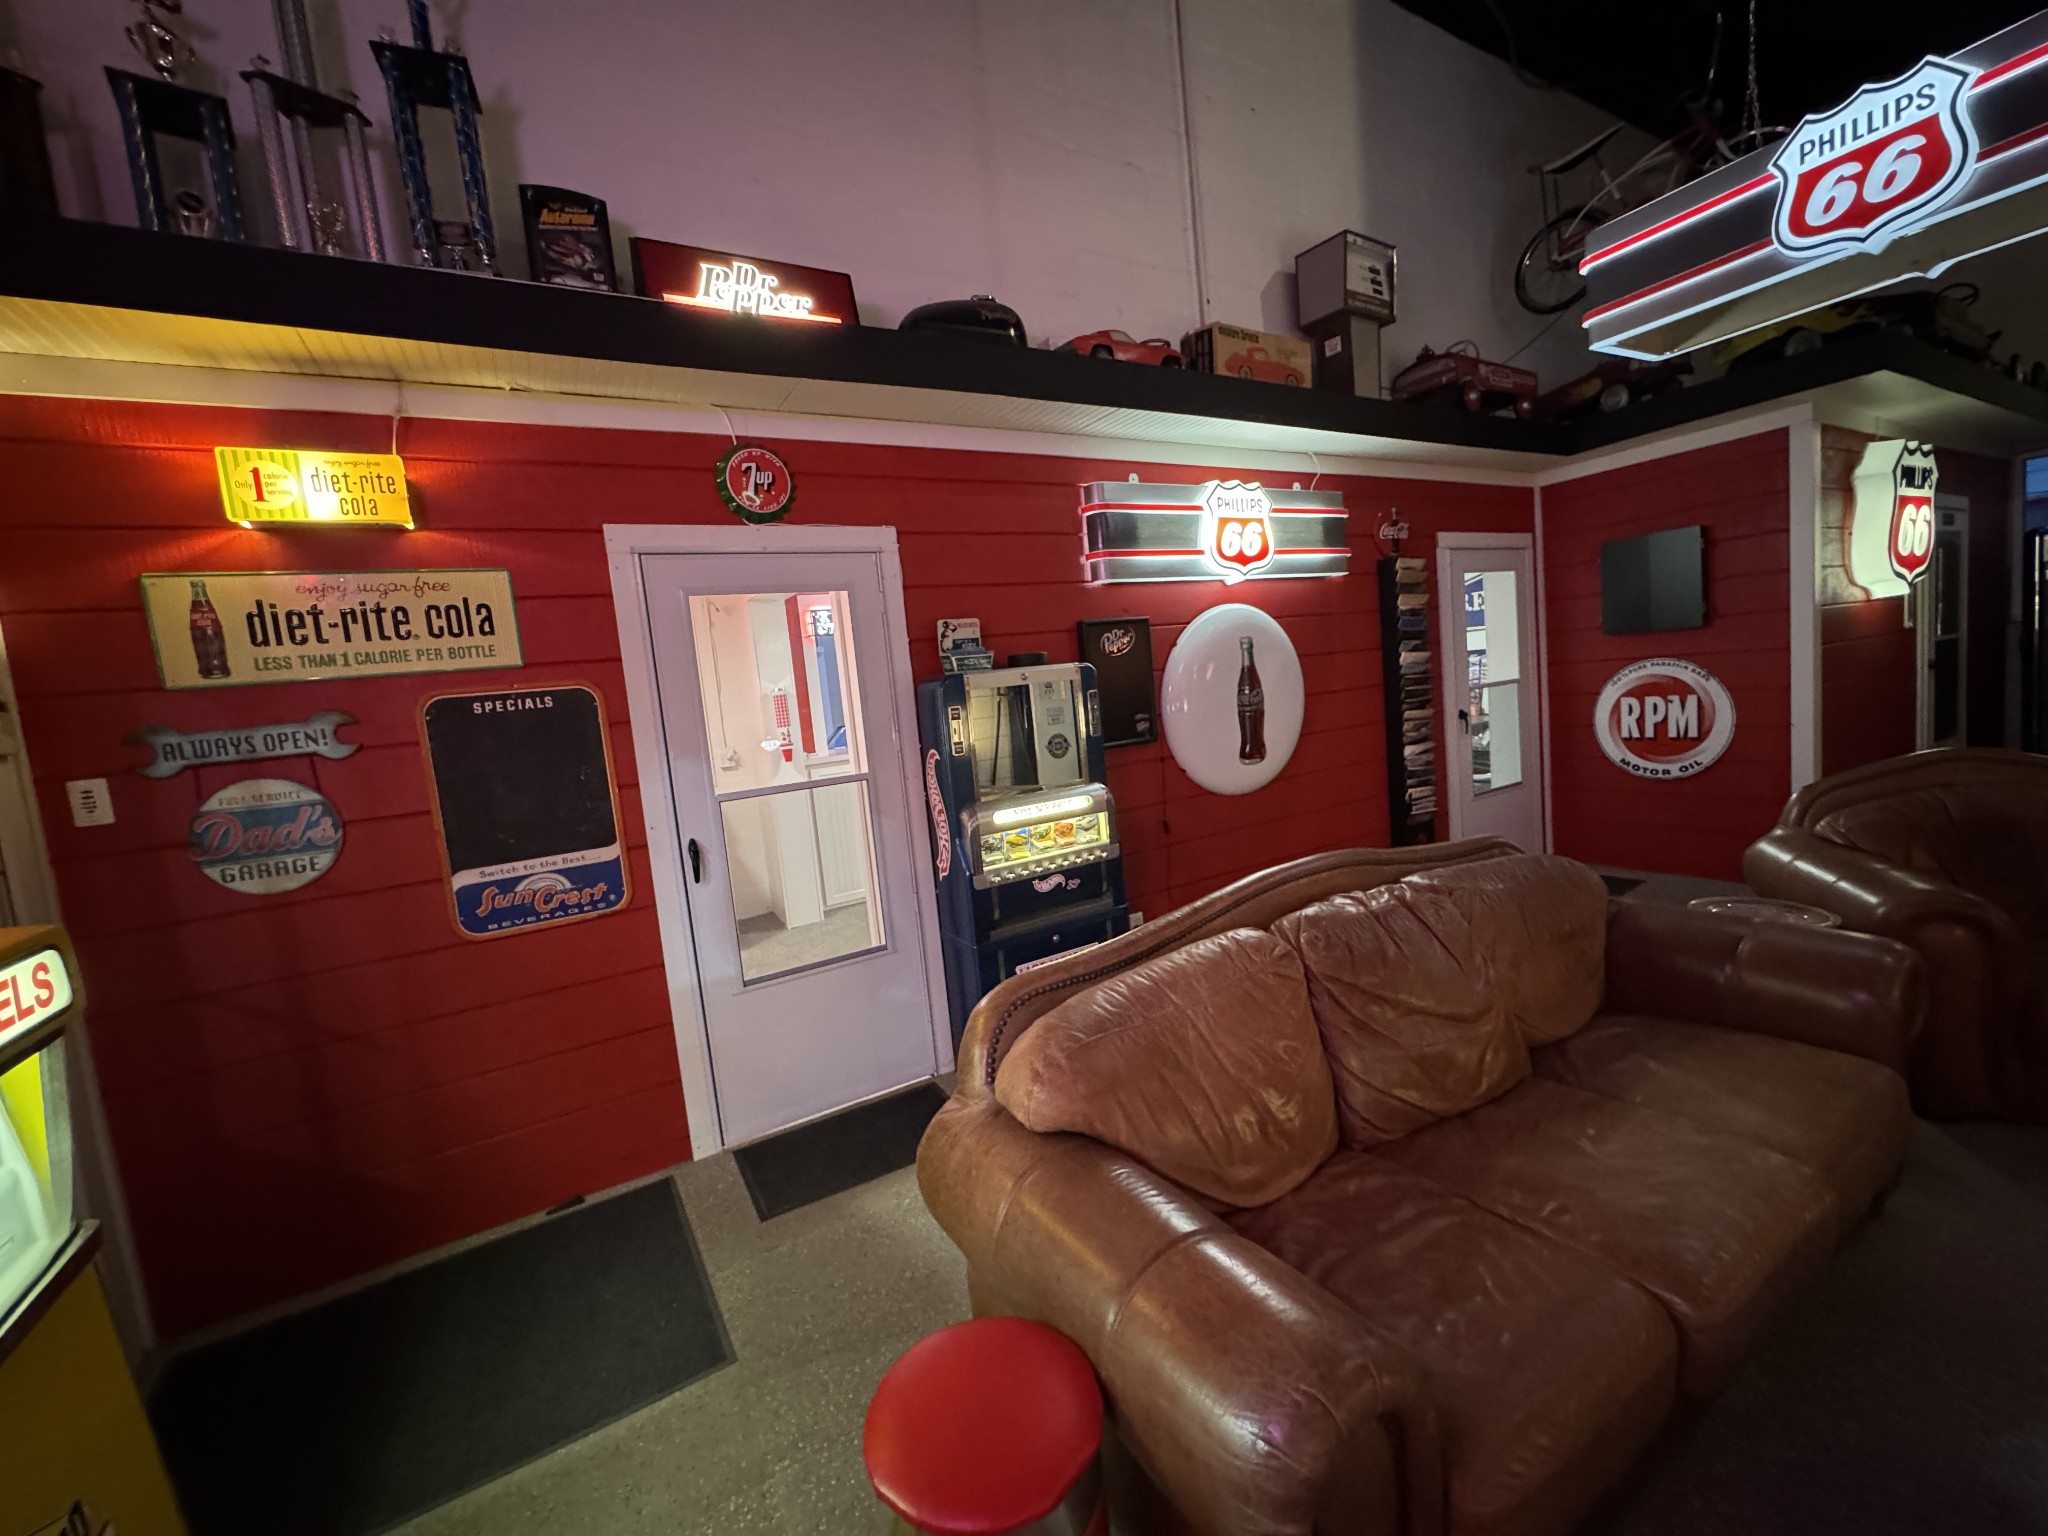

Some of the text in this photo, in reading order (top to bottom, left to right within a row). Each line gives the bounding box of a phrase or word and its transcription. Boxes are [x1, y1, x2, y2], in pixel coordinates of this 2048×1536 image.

[1799, 82, 1936, 166] PHILLIPS
[1804, 134, 1927, 227] 66
[698, 262, 814, 315] Pepper
[732, 261, 778, 292] Dr
[234, 467, 270, 503] Only 1
[309, 467, 398, 494] diet-rite
[1900, 464, 1934, 490] PHILLIPS
[339, 495, 379, 516] cola
[1217, 496, 1263, 513] PHILLIPS
[1220, 521, 1263, 557] 66
[1898, 503, 1931, 557] 66
[295, 576, 451, 602] enjoy sugar free
[246, 599, 413, 648] diet-rite
[424, 597, 497, 640] cola
[1112, 629, 1125, 639] Dr
[1103, 632, 1132, 654] Pepper
[253, 644, 497, 671] LESS THAN 1 CALORIE PER BOTTLE
[473, 696, 554, 714] SPECIALS
[1620, 694, 1699, 740] RPM
[161, 728, 329, 763] ALWAYS OPEN!
[1619, 758, 1704, 776] MOTOR OIL
[188, 804, 343, 862] Dad's
[220, 856, 322, 884] GARAGE
[478, 863, 520, 879] Switch
[523, 862, 536, 871] to
[539, 857, 559, 869] the
[487, 902, 607, 930] BEVERAGES
